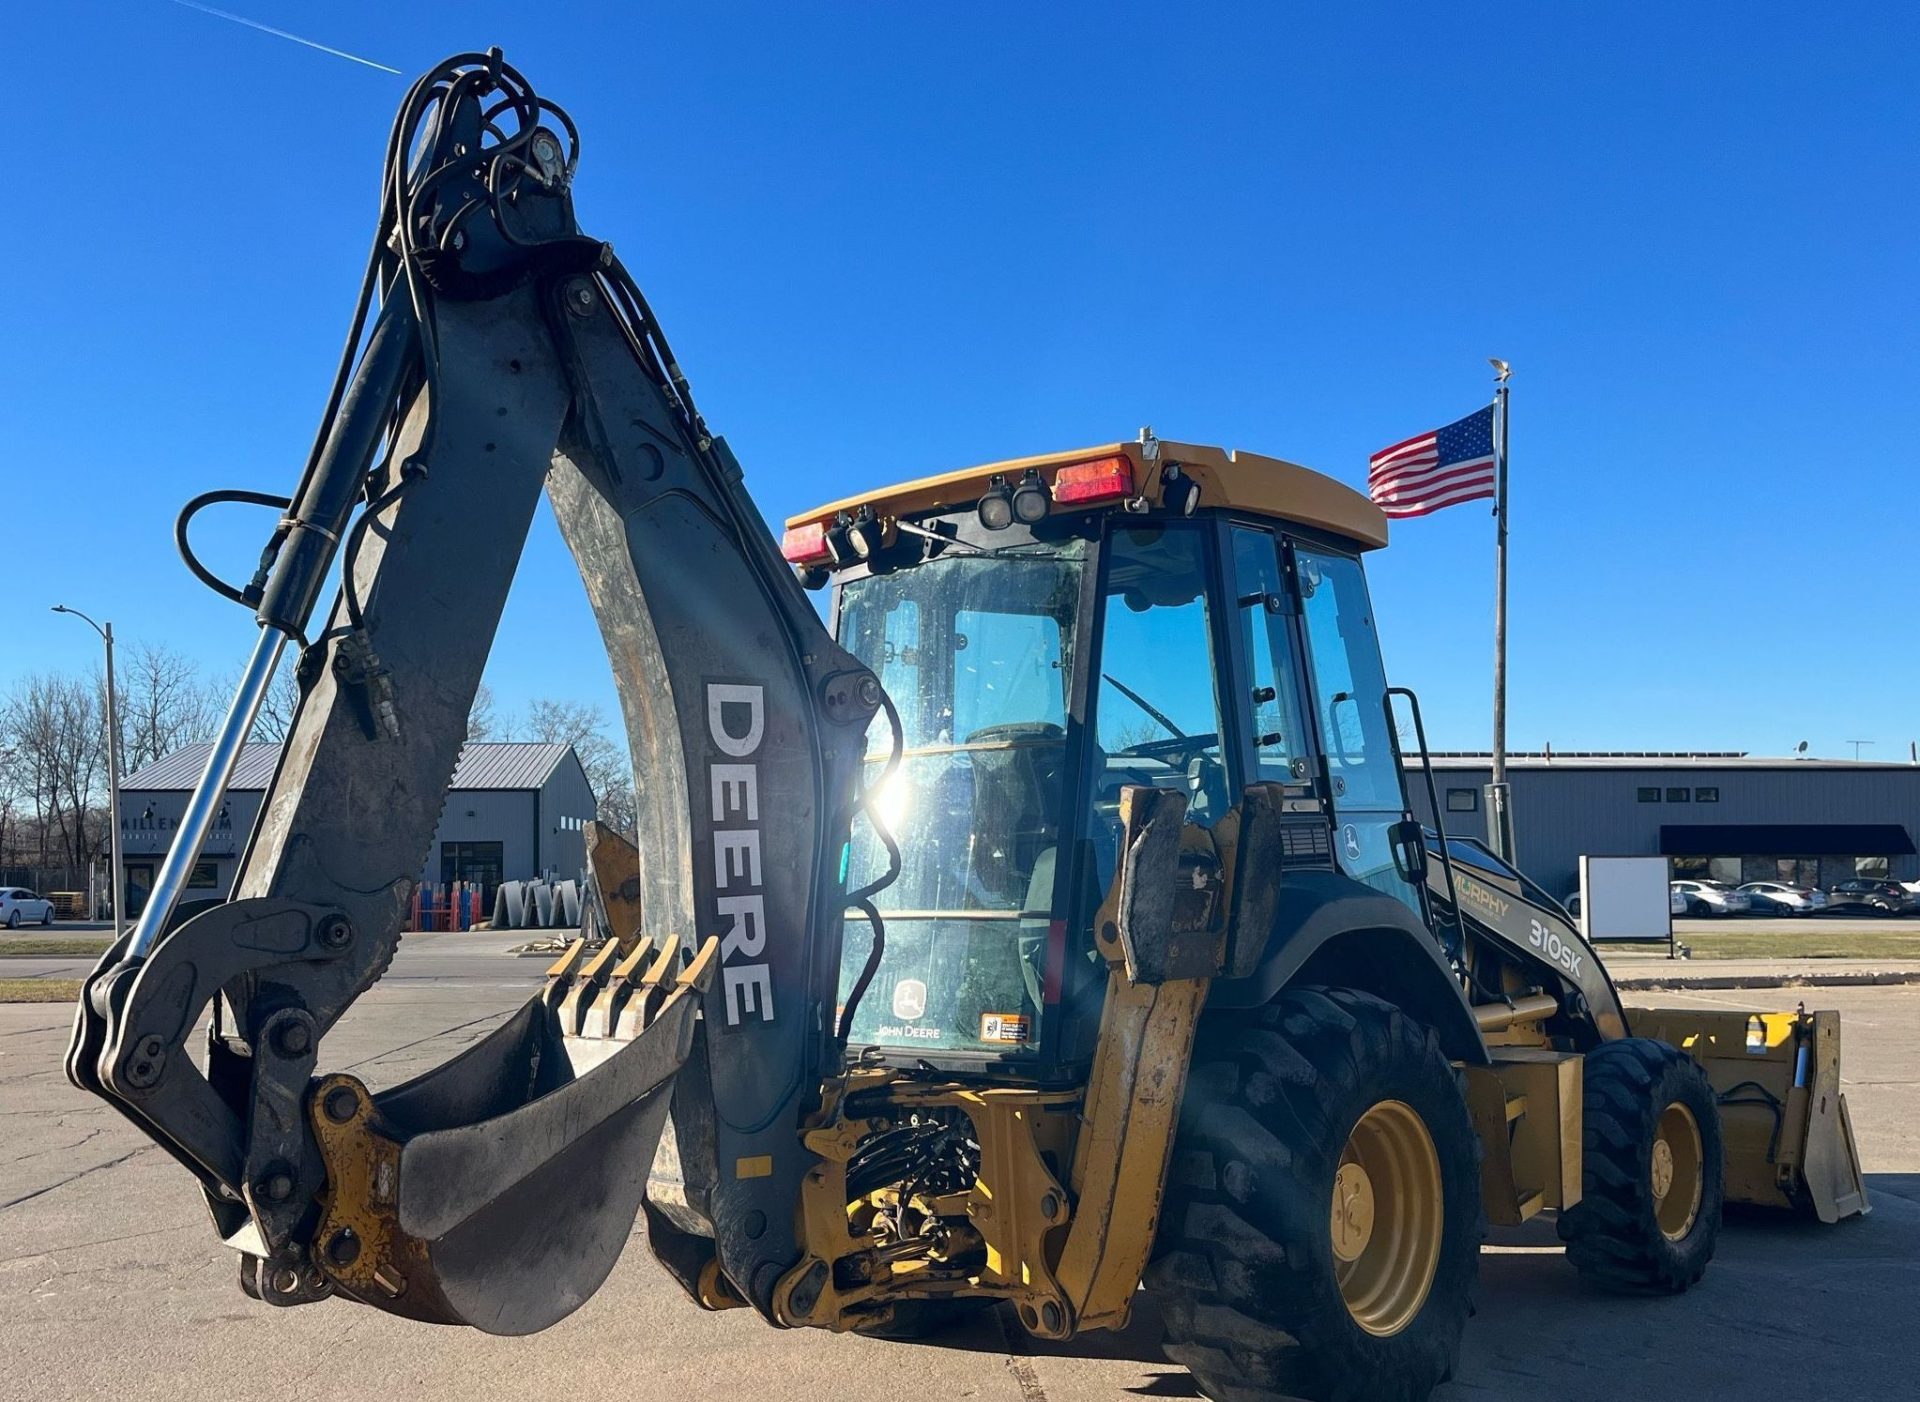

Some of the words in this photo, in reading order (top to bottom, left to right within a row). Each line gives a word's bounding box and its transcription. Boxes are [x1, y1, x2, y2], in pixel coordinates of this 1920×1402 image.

[121, 817, 232, 830] MILLENM
[707, 683, 776, 1026] DEERE
[1528, 918, 1583, 978] 310SK
[874, 1024, 903, 1037] JOHN
[904, 1025, 940, 1039] DEERE
